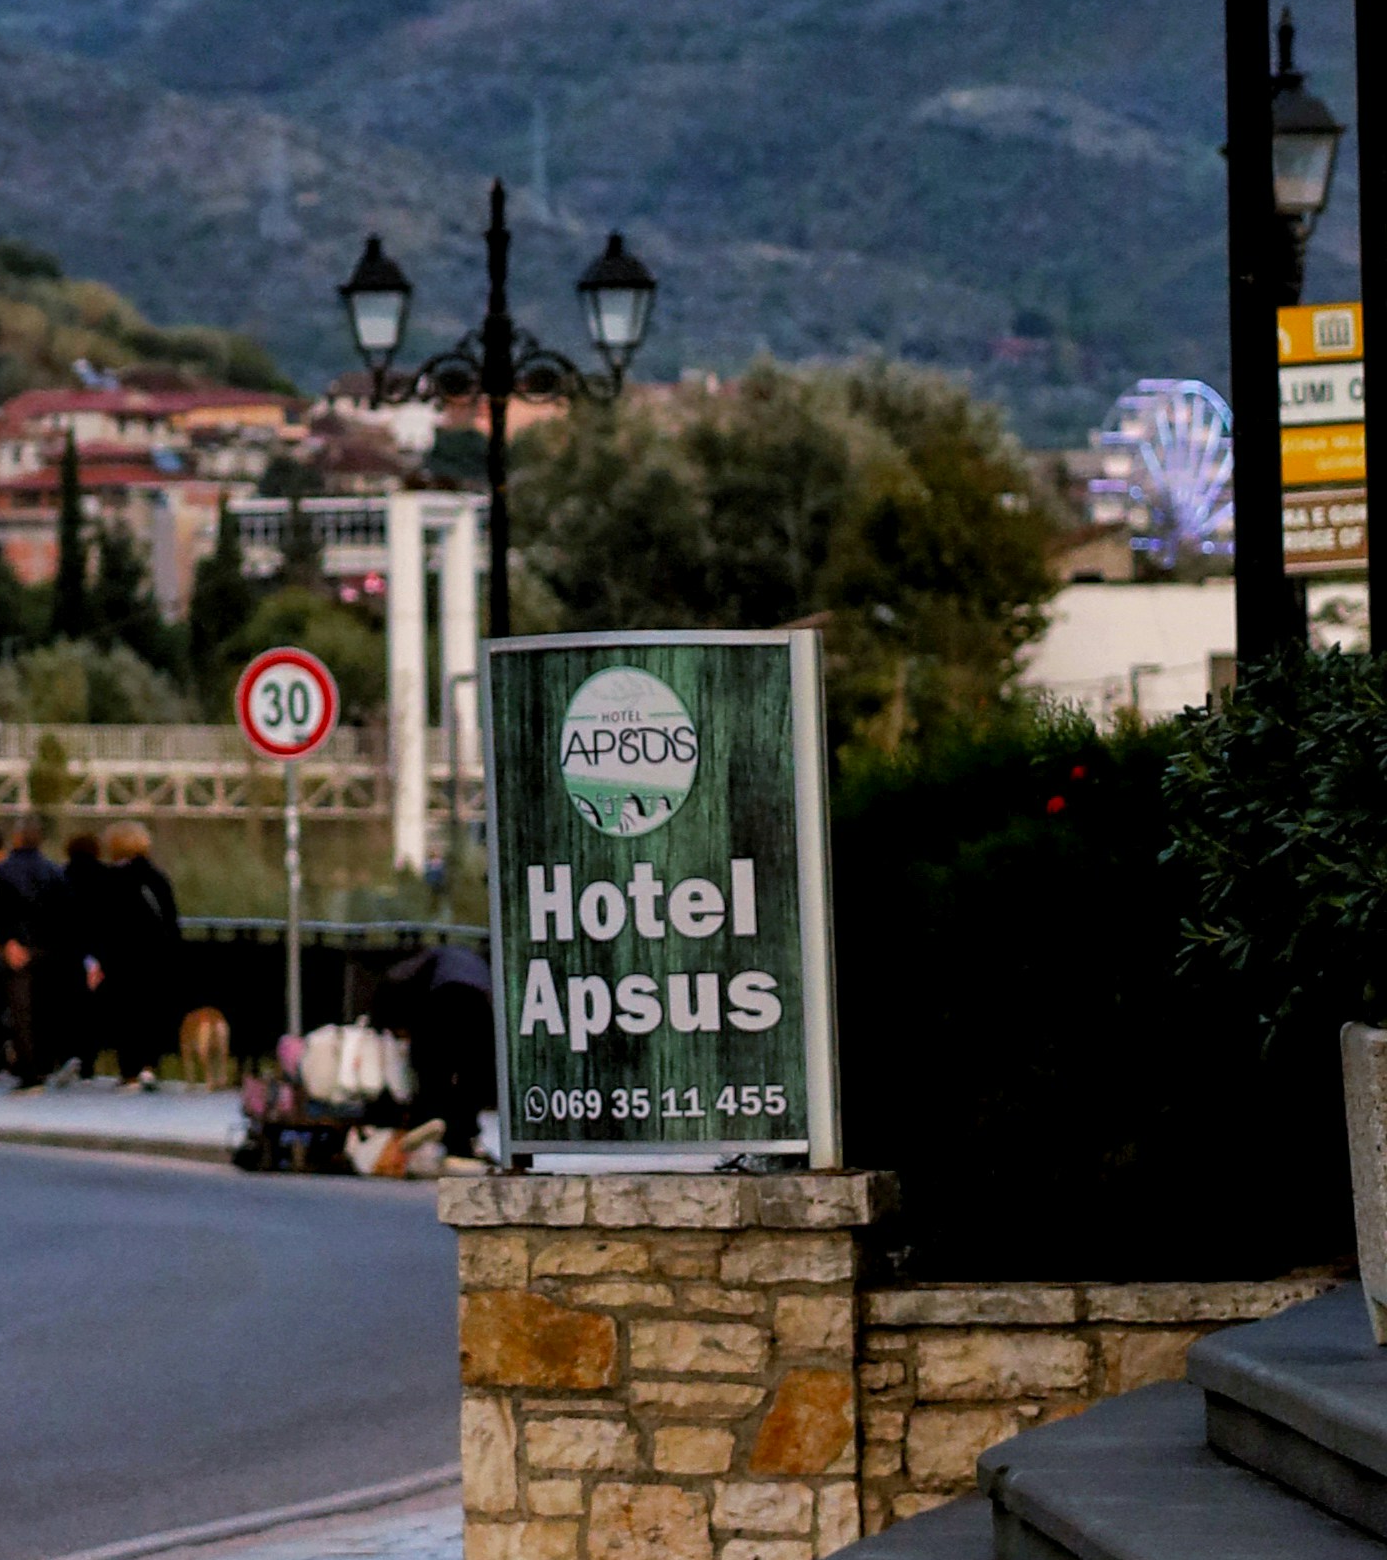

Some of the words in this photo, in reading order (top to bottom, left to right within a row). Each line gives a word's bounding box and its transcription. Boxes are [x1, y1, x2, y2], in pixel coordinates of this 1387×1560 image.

[262, 681, 310, 727] 30
[601, 710, 643, 723] HOTEL
[561, 725, 697, 767] APSUS
[527, 857, 758, 942] Hotel
[519, 958, 783, 1052] Apsus
[550, 1088, 603, 1121] 069
[610, 1087, 652, 1120] 35
[660, 1086, 707, 1118] 11
[714, 1084, 788, 1117] 455
